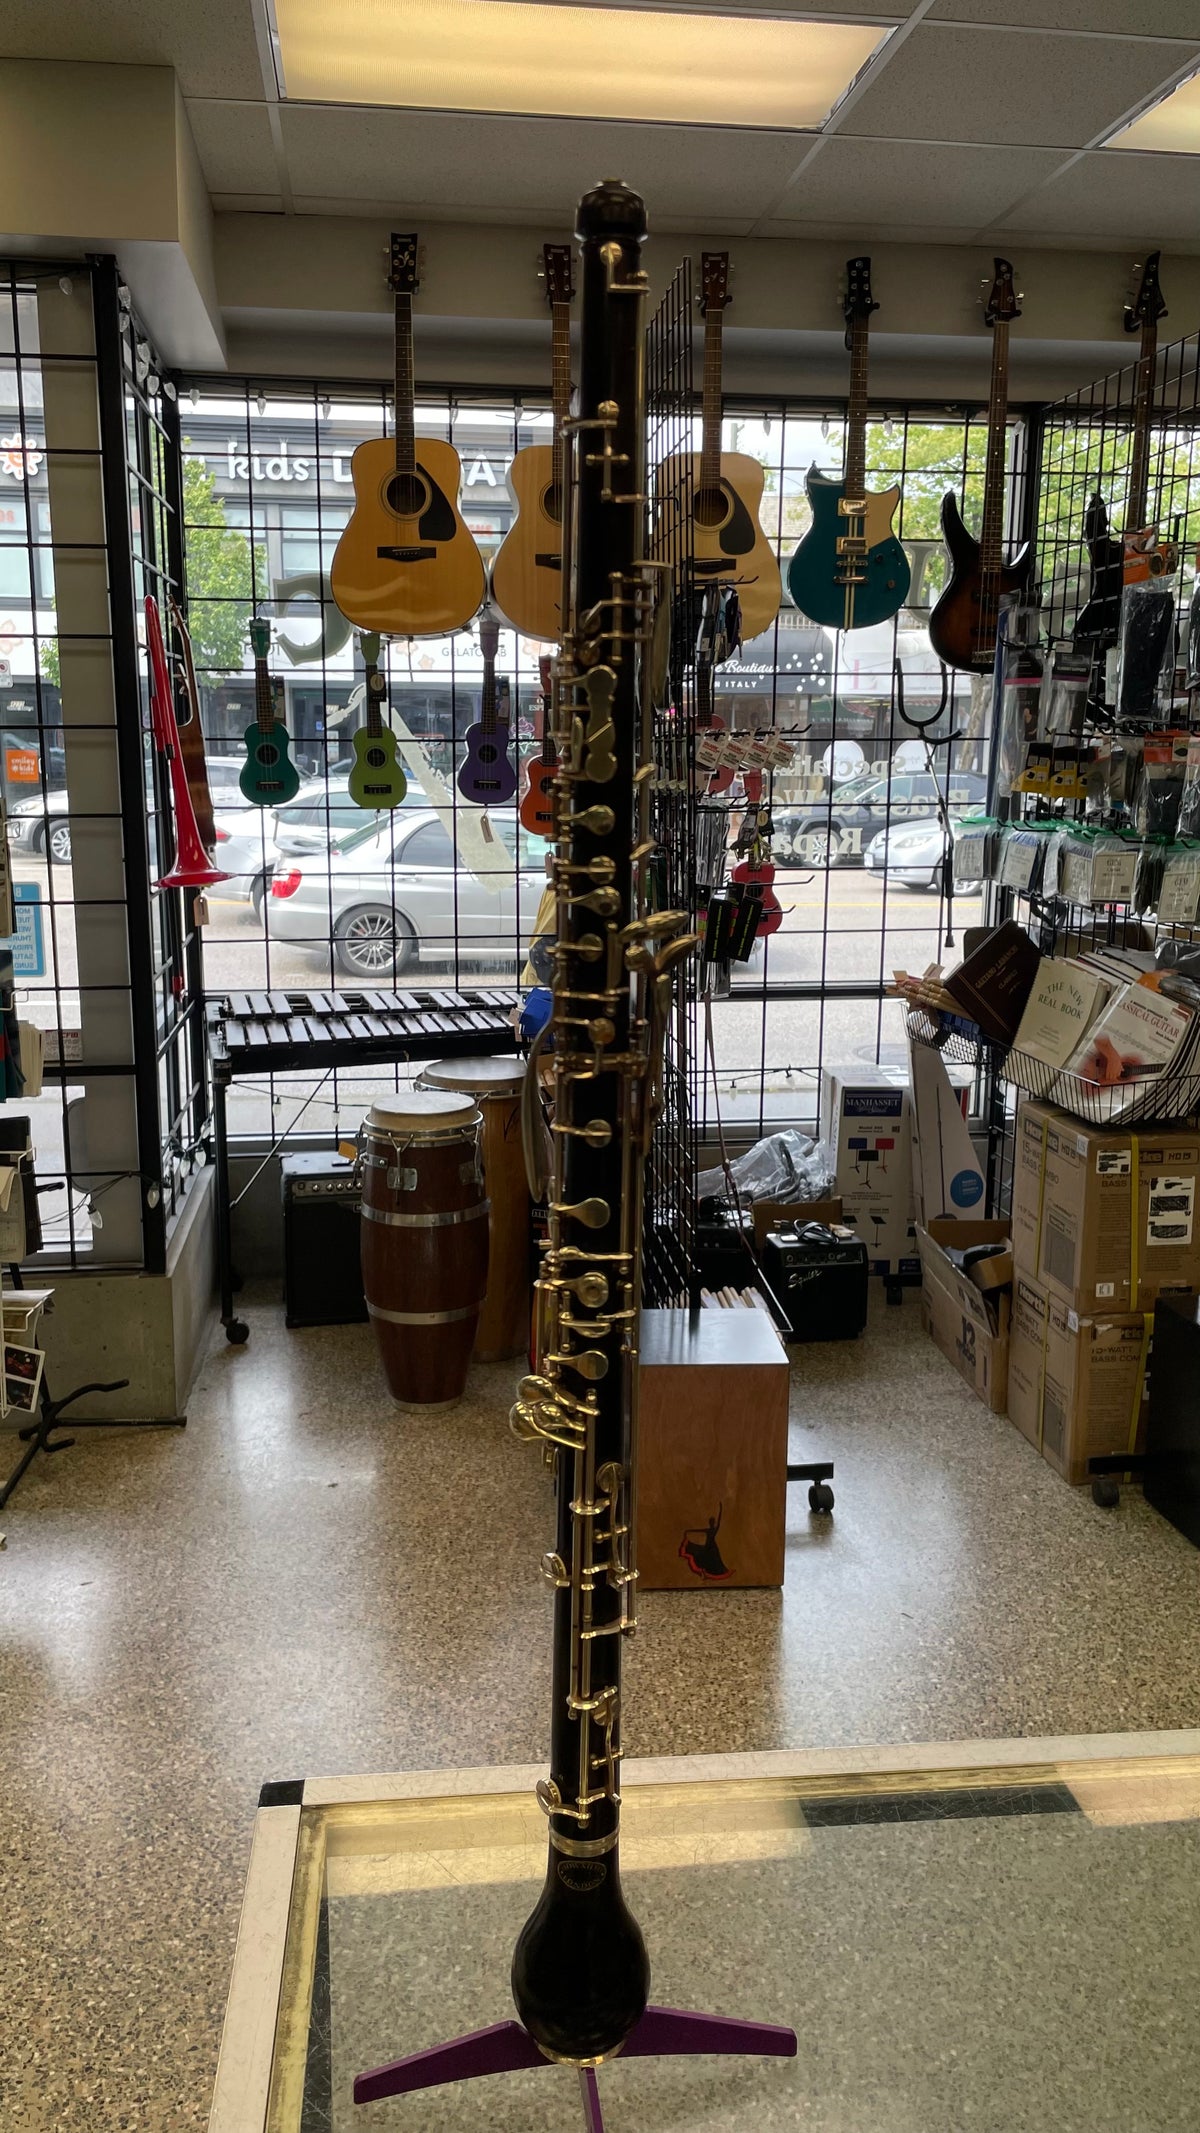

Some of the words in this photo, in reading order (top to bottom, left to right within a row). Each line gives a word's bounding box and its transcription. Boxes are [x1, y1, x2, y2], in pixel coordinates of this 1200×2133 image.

[228, 442, 310, 482] kids
[1047, 982, 1065, 994] THE
[1069, 985, 1085, 1006] NEW
[1037, 994, 1058, 1009] REAL
[1060, 1002, 1085, 1019] BOOK
[1150, 1017, 1180, 1038] GUITAR
[845, 1098, 899, 1107] MANHASSET
[1101, 1179, 1128, 1187] BASS
